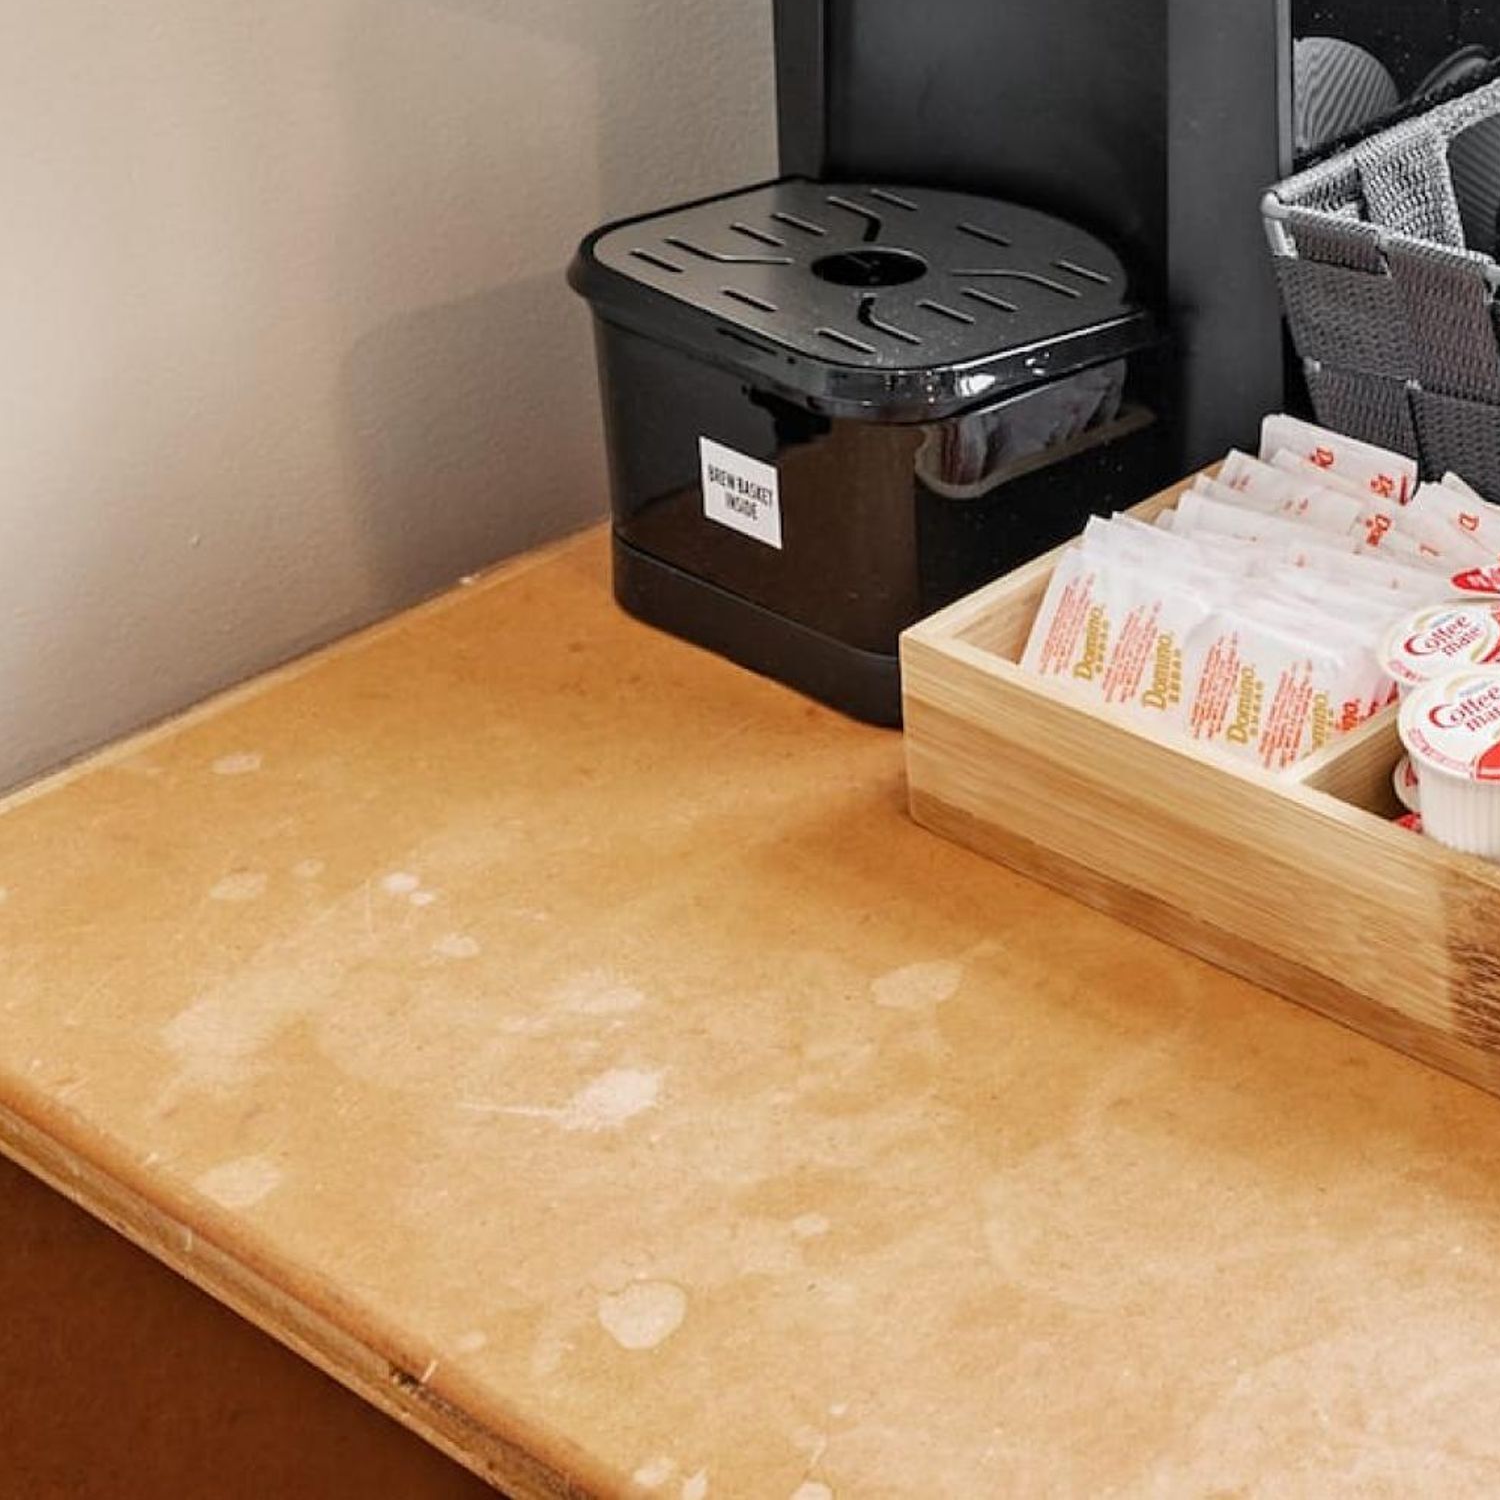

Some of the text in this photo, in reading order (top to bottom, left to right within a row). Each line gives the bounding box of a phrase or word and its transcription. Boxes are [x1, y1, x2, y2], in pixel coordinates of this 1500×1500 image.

[707, 463, 773, 508] BREW BASKET
[725, 492, 758, 522] INSIDE
[1403, 616, 1468, 656] Coffee
